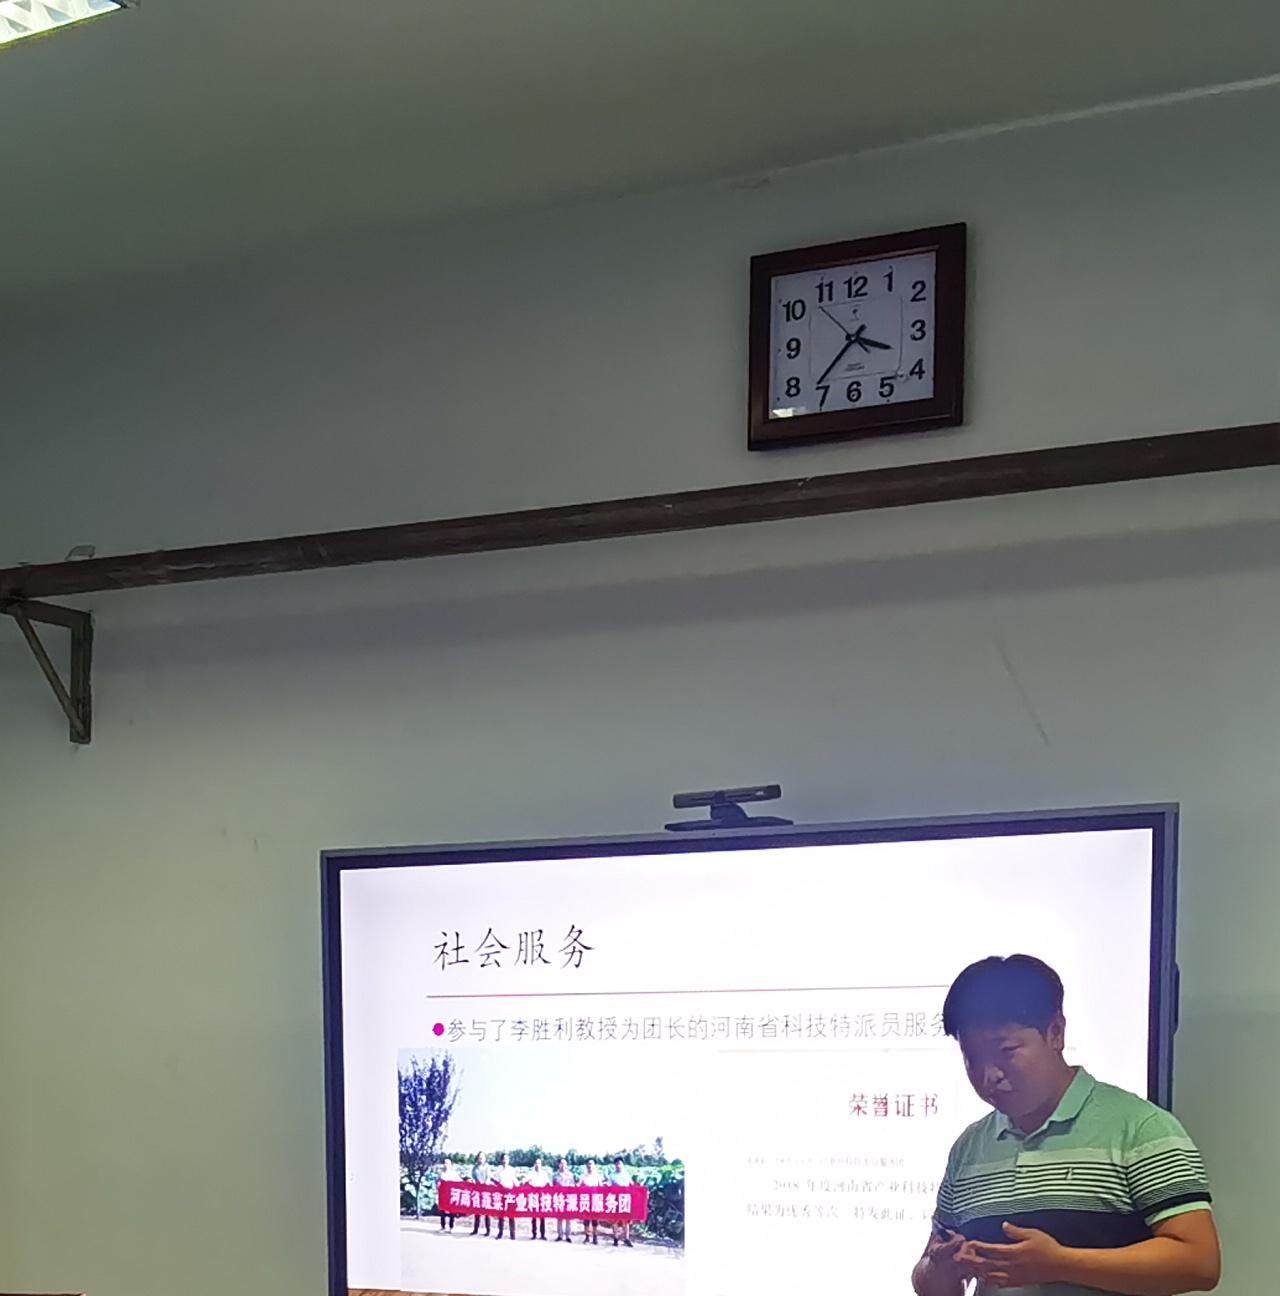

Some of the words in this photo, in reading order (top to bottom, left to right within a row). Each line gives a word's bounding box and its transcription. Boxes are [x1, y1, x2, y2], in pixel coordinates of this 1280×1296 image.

[815, 280, 834, 303] 11
[843, 275, 868, 298] 12
[883, 271, 894, 293] 1
[910, 280, 927, 302] 2
[783, 300, 806, 322] 10
[910, 319, 926, 341] 3
[786, 338, 801, 359] 9
[909, 358, 925, 380] 4
[785, 377, 801, 398] 8
[816, 385, 831, 408] 7
[846, 381, 862, 402] 6
[878, 376, 895, 398] 5
[433, 924, 596, 971] 社会服务
[849, 1093, 939, 1118] 荣誉证书
[450, 1187, 632, 1214] 河南省蔬菜产业科技特派员服务团
